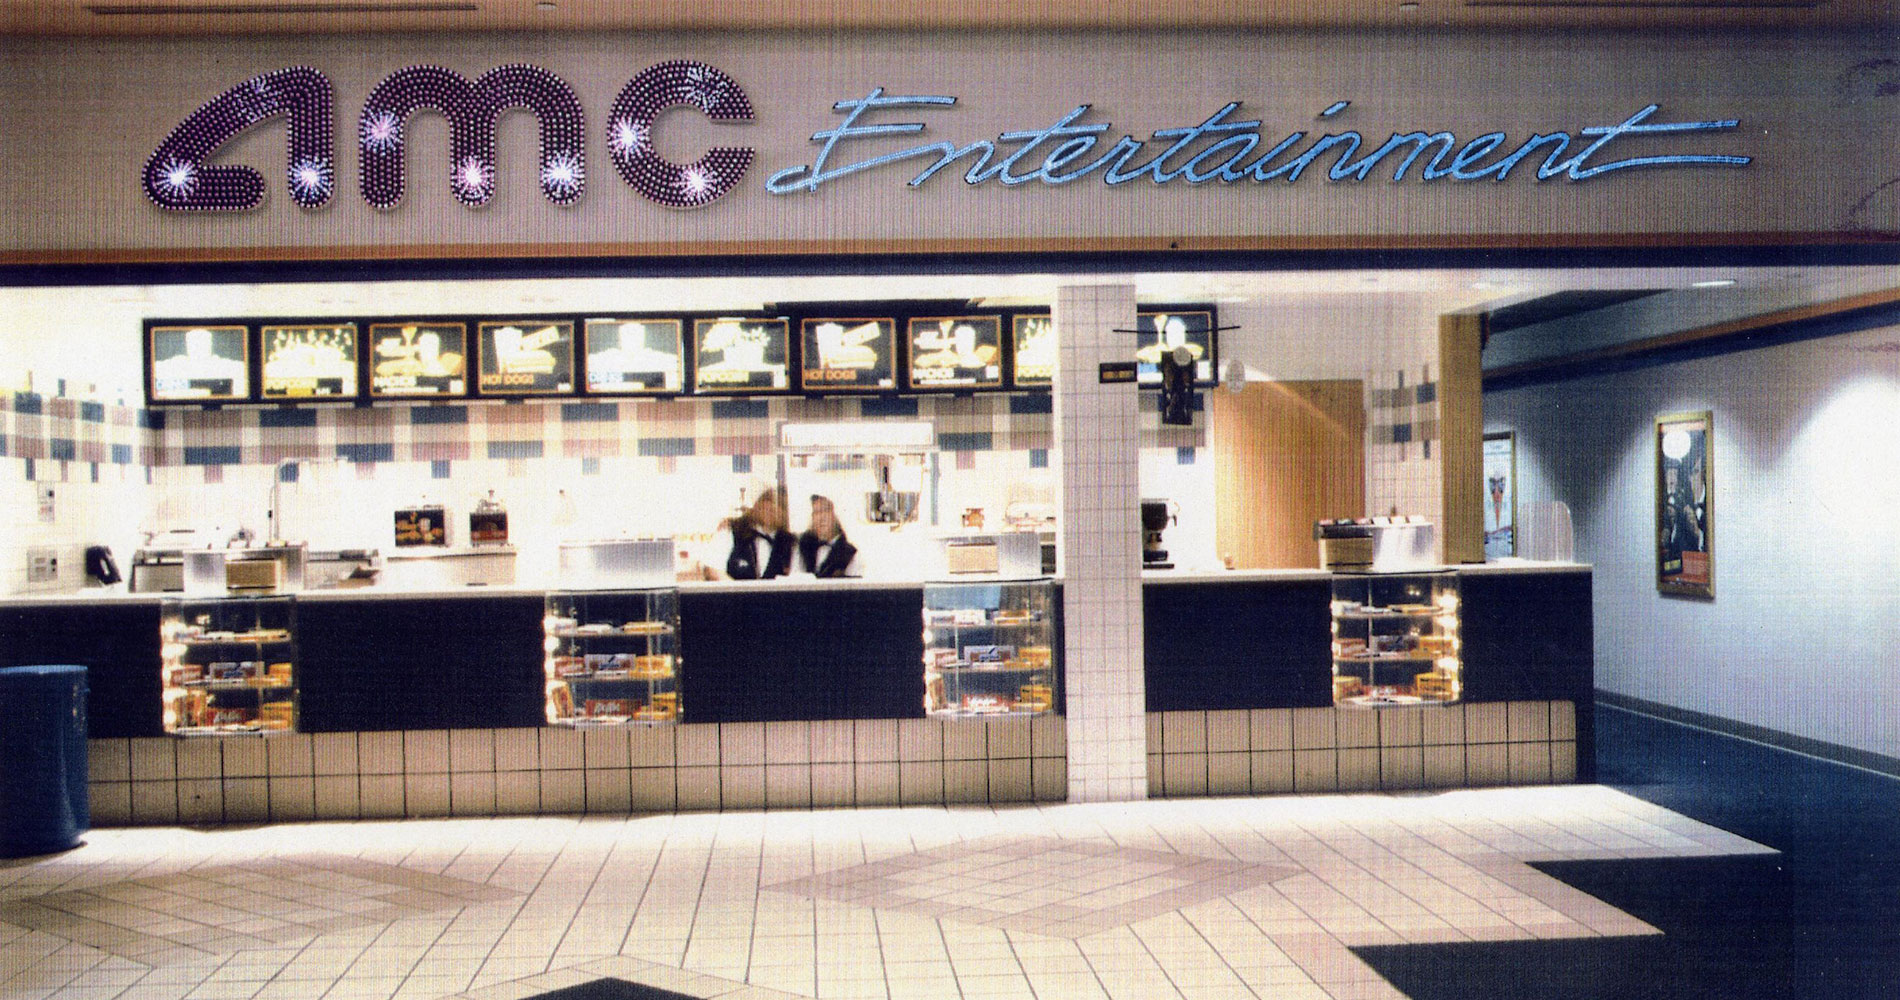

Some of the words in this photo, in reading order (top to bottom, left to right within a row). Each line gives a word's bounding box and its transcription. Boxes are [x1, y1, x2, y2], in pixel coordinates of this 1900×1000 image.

[766, 86, 1754, 193] Entertainment
[482, 374, 502, 385] HOT
[503, 374, 534, 385] DOGS
[805, 369, 824, 380] HOT
[825, 369, 857, 380] DOGS
